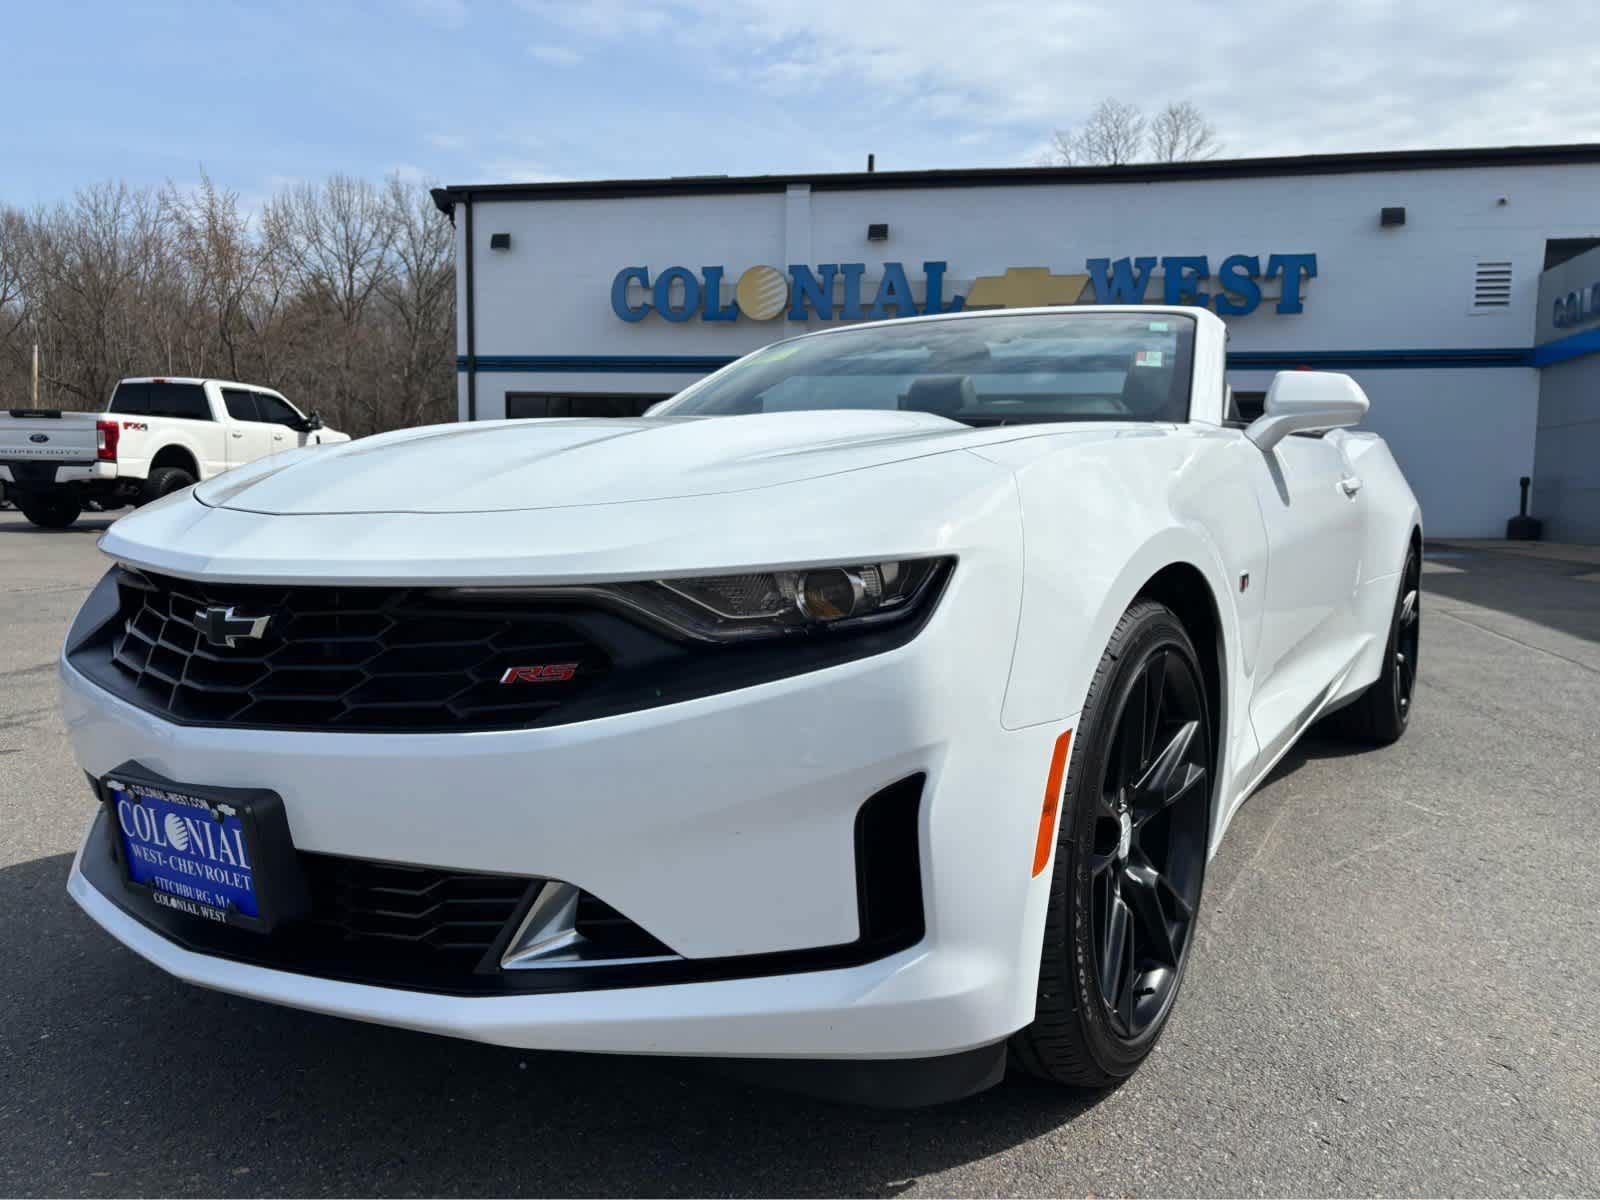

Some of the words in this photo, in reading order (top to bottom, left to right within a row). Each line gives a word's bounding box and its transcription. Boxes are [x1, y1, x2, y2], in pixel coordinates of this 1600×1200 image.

[611, 261, 967, 322] COLONIAL
[1086, 253, 1317, 316] WEST
[122, 421, 149, 432] FX4
[500, 663, 578, 684] RS
[117, 799, 252, 870] COLONIAL
[200, 904, 227, 924] WEST
